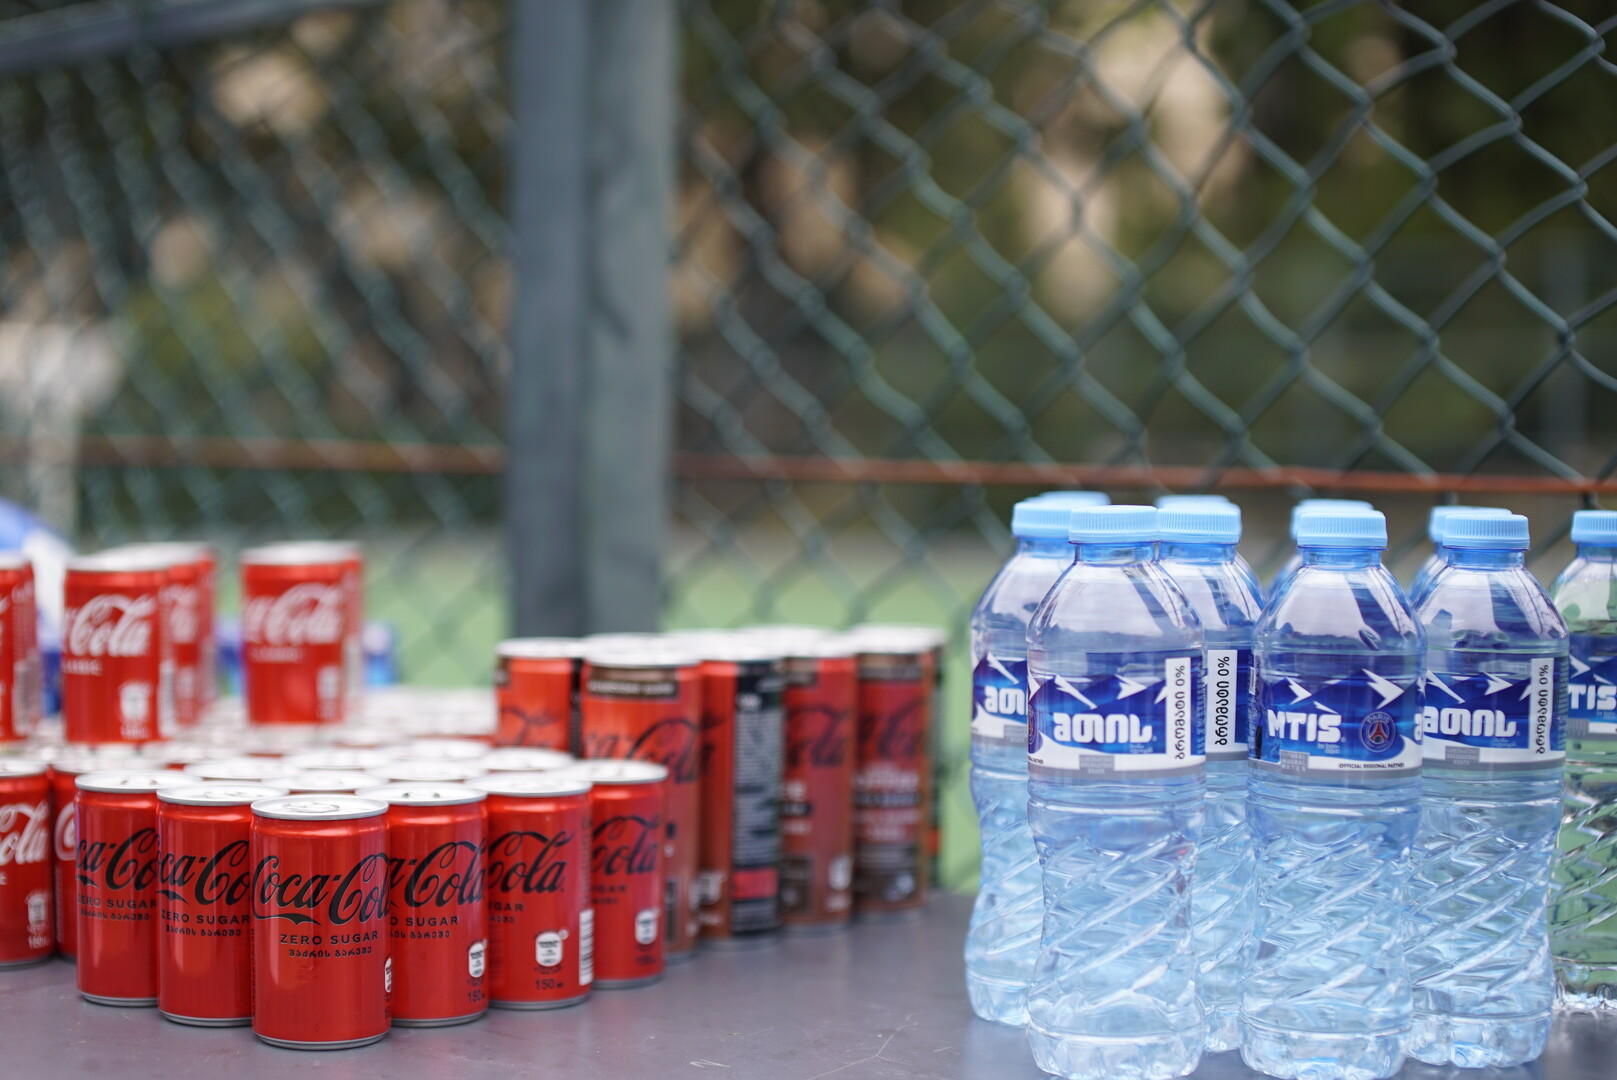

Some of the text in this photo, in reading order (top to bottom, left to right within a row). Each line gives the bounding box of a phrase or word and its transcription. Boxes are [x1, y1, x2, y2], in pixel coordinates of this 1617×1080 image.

[1175, 665, 1186, 687] 0%
[1539, 664, 1549, 685] 0%
[1214, 656, 1230, 746] ბრომატი 0%
[1568, 684, 1617, 710] TIS
[1267, 709, 1342, 743] MTIS
[1366, 713, 1391, 725] PARIS
[161, 909, 250, 925] ZERO SUGAR
[405, 916, 459, 927] SUGAR
[280, 934, 323, 945] ZERO
[330, 931, 379, 945] SUGAR
